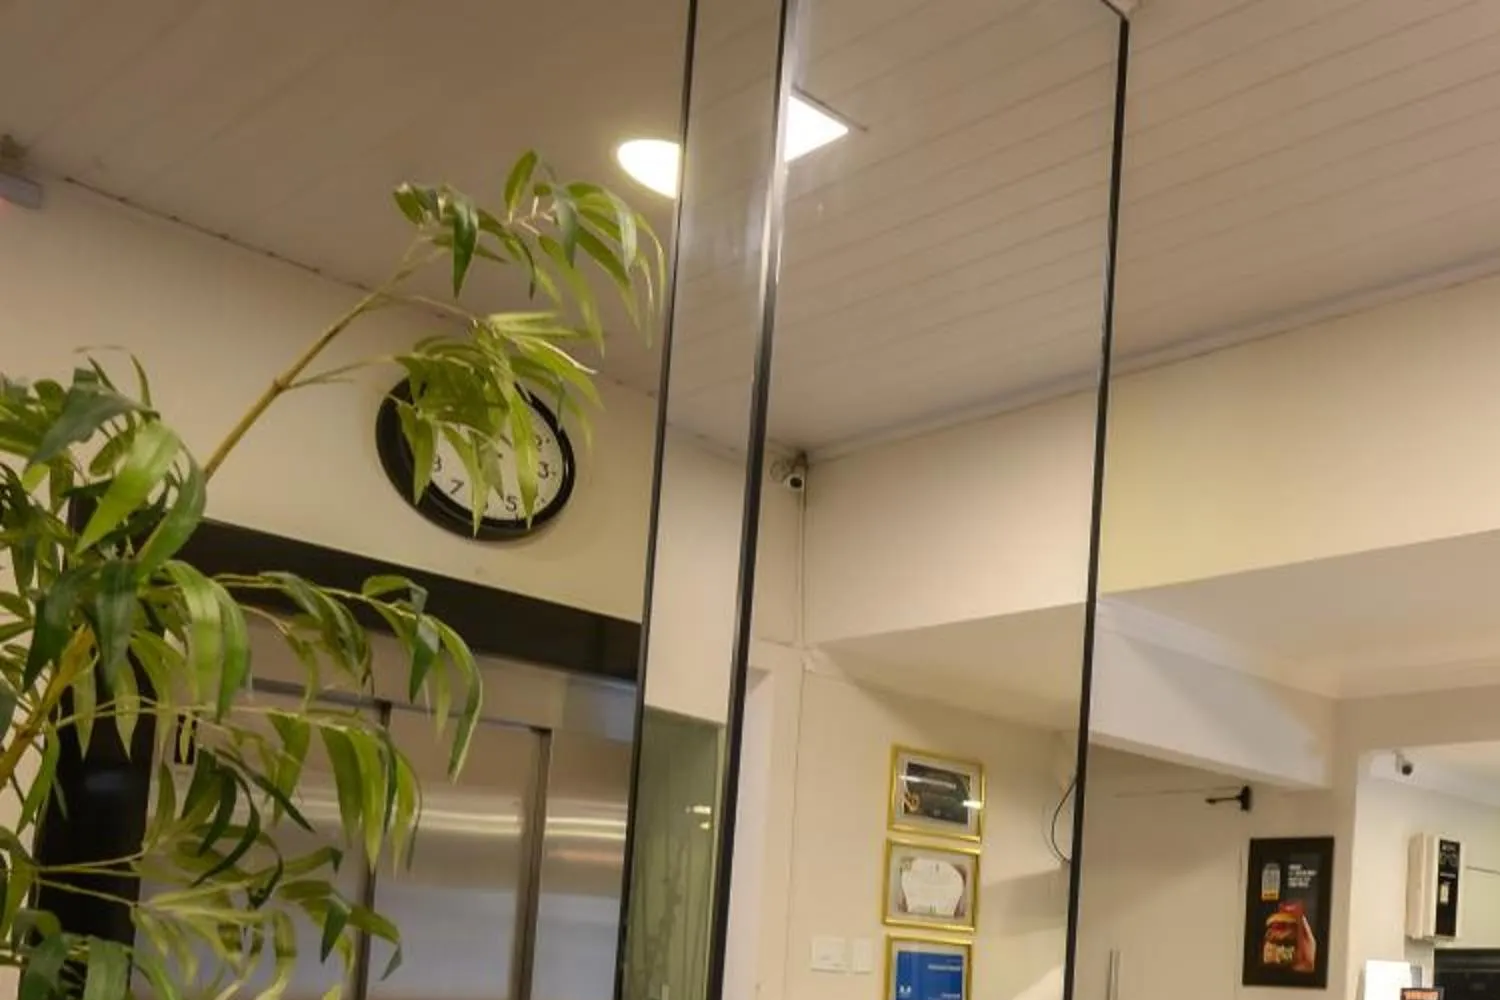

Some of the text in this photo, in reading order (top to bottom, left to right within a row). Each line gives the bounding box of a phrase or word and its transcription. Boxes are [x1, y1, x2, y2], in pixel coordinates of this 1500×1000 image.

[538, 461, 549, 480] 3
[451, 478, 464, 494] 7
[505, 495, 517, 512] 5
